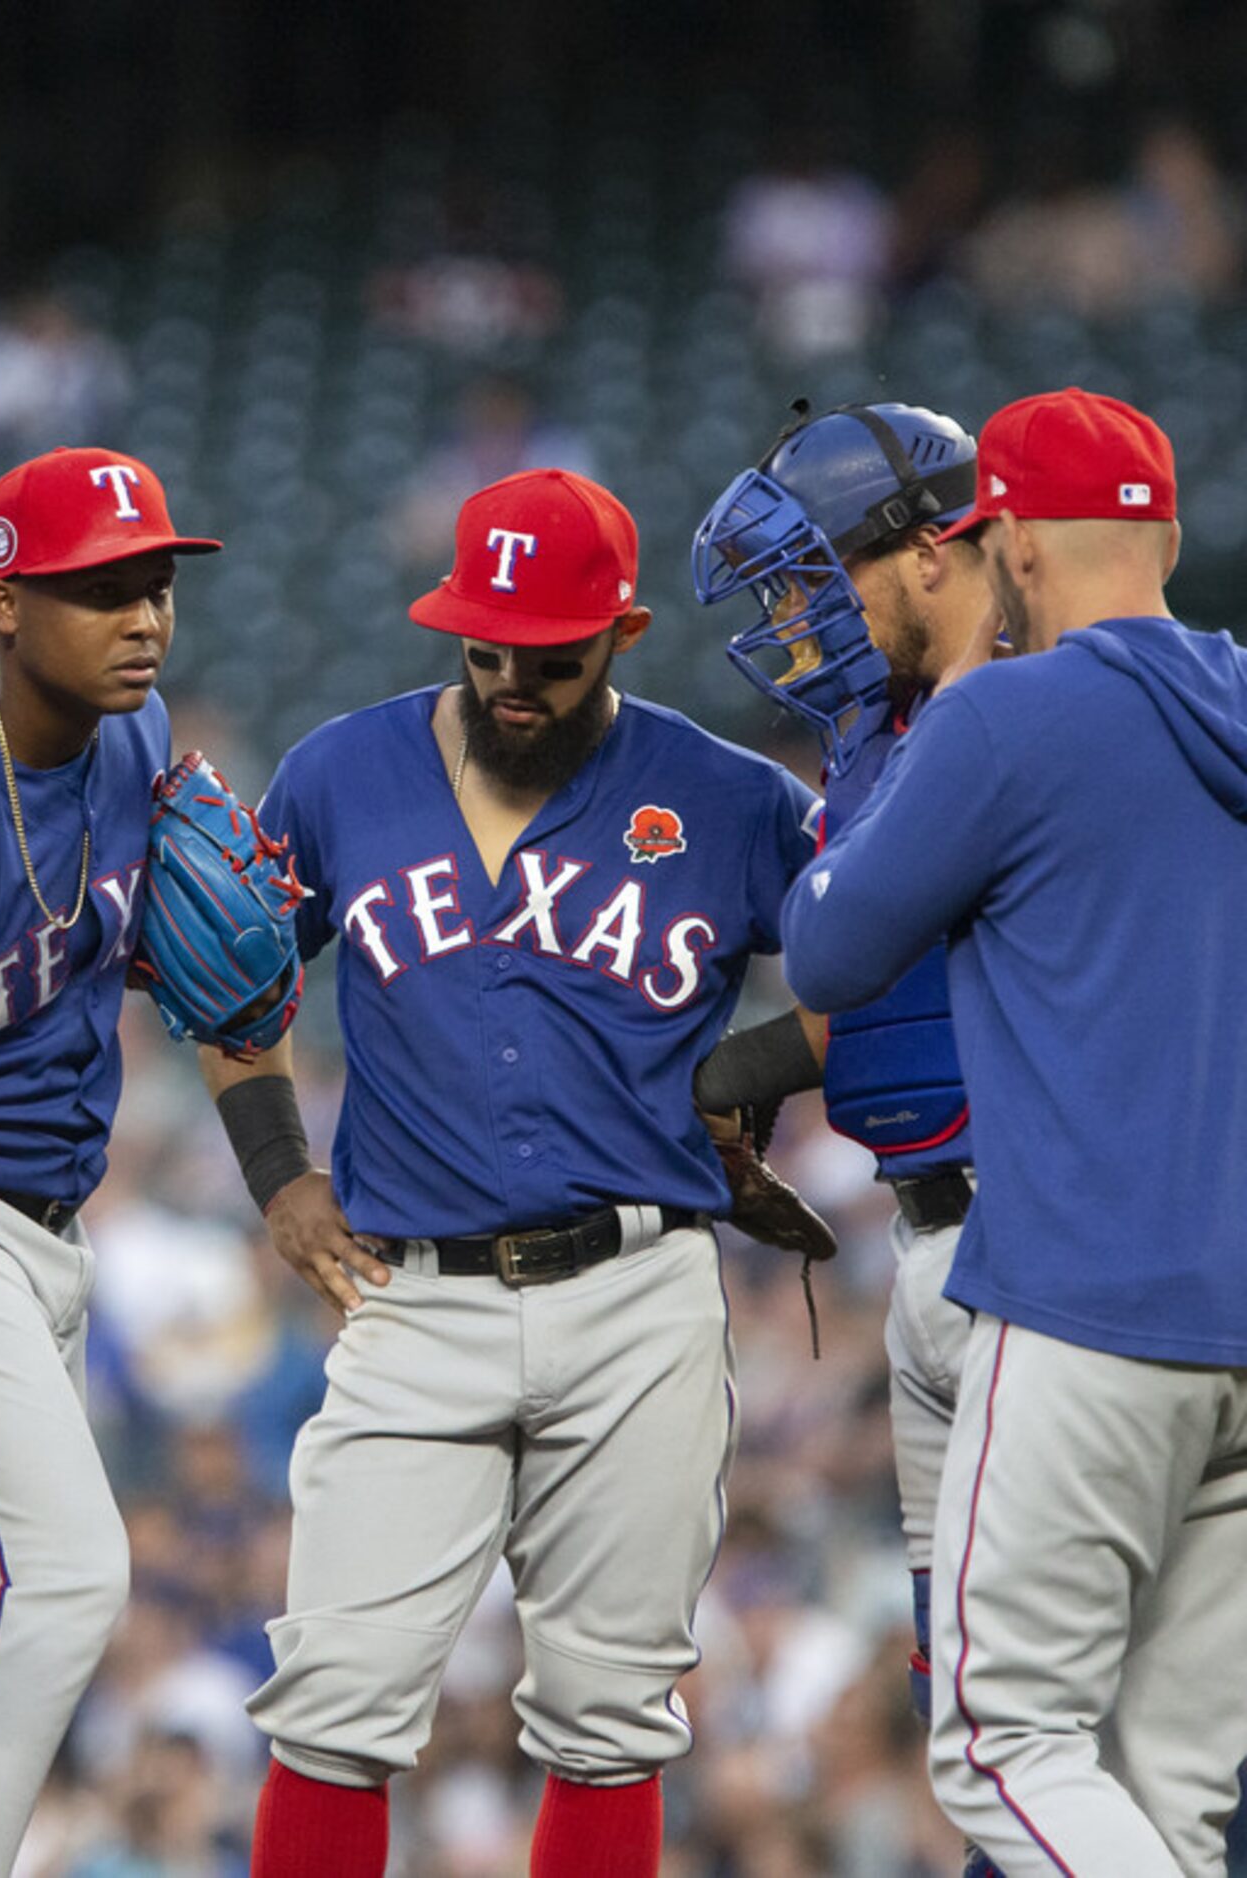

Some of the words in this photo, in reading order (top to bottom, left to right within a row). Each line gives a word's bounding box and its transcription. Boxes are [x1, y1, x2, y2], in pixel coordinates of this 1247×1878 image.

[89, 464, 141, 521] T
[486, 527, 537, 592] T
[343, 852, 718, 1010] TEXAS
